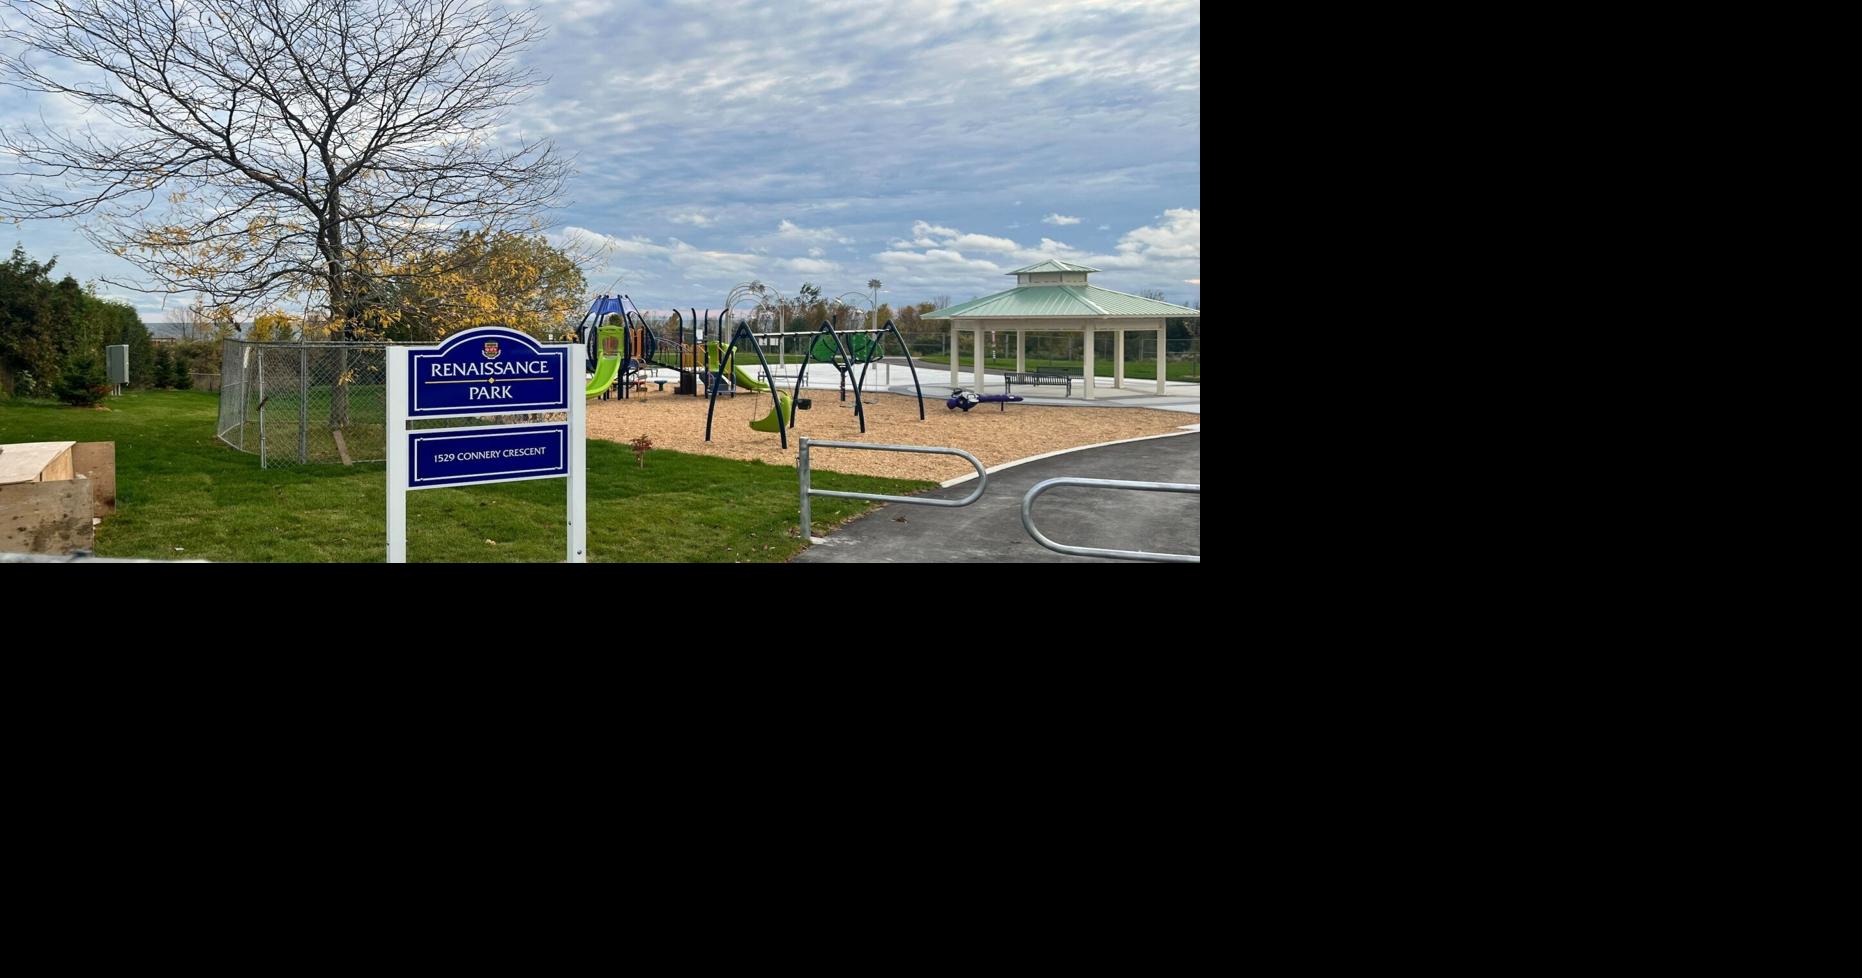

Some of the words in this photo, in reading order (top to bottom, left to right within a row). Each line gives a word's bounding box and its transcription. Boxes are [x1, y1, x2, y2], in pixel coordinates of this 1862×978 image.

[431, 360, 549, 377] RENAISSANCE
[469, 385, 513, 400] PARK
[434, 453, 455, 463] 1529
[457, 449, 501, 461] CONNERY
[503, 446, 546, 457] CRESCENT
